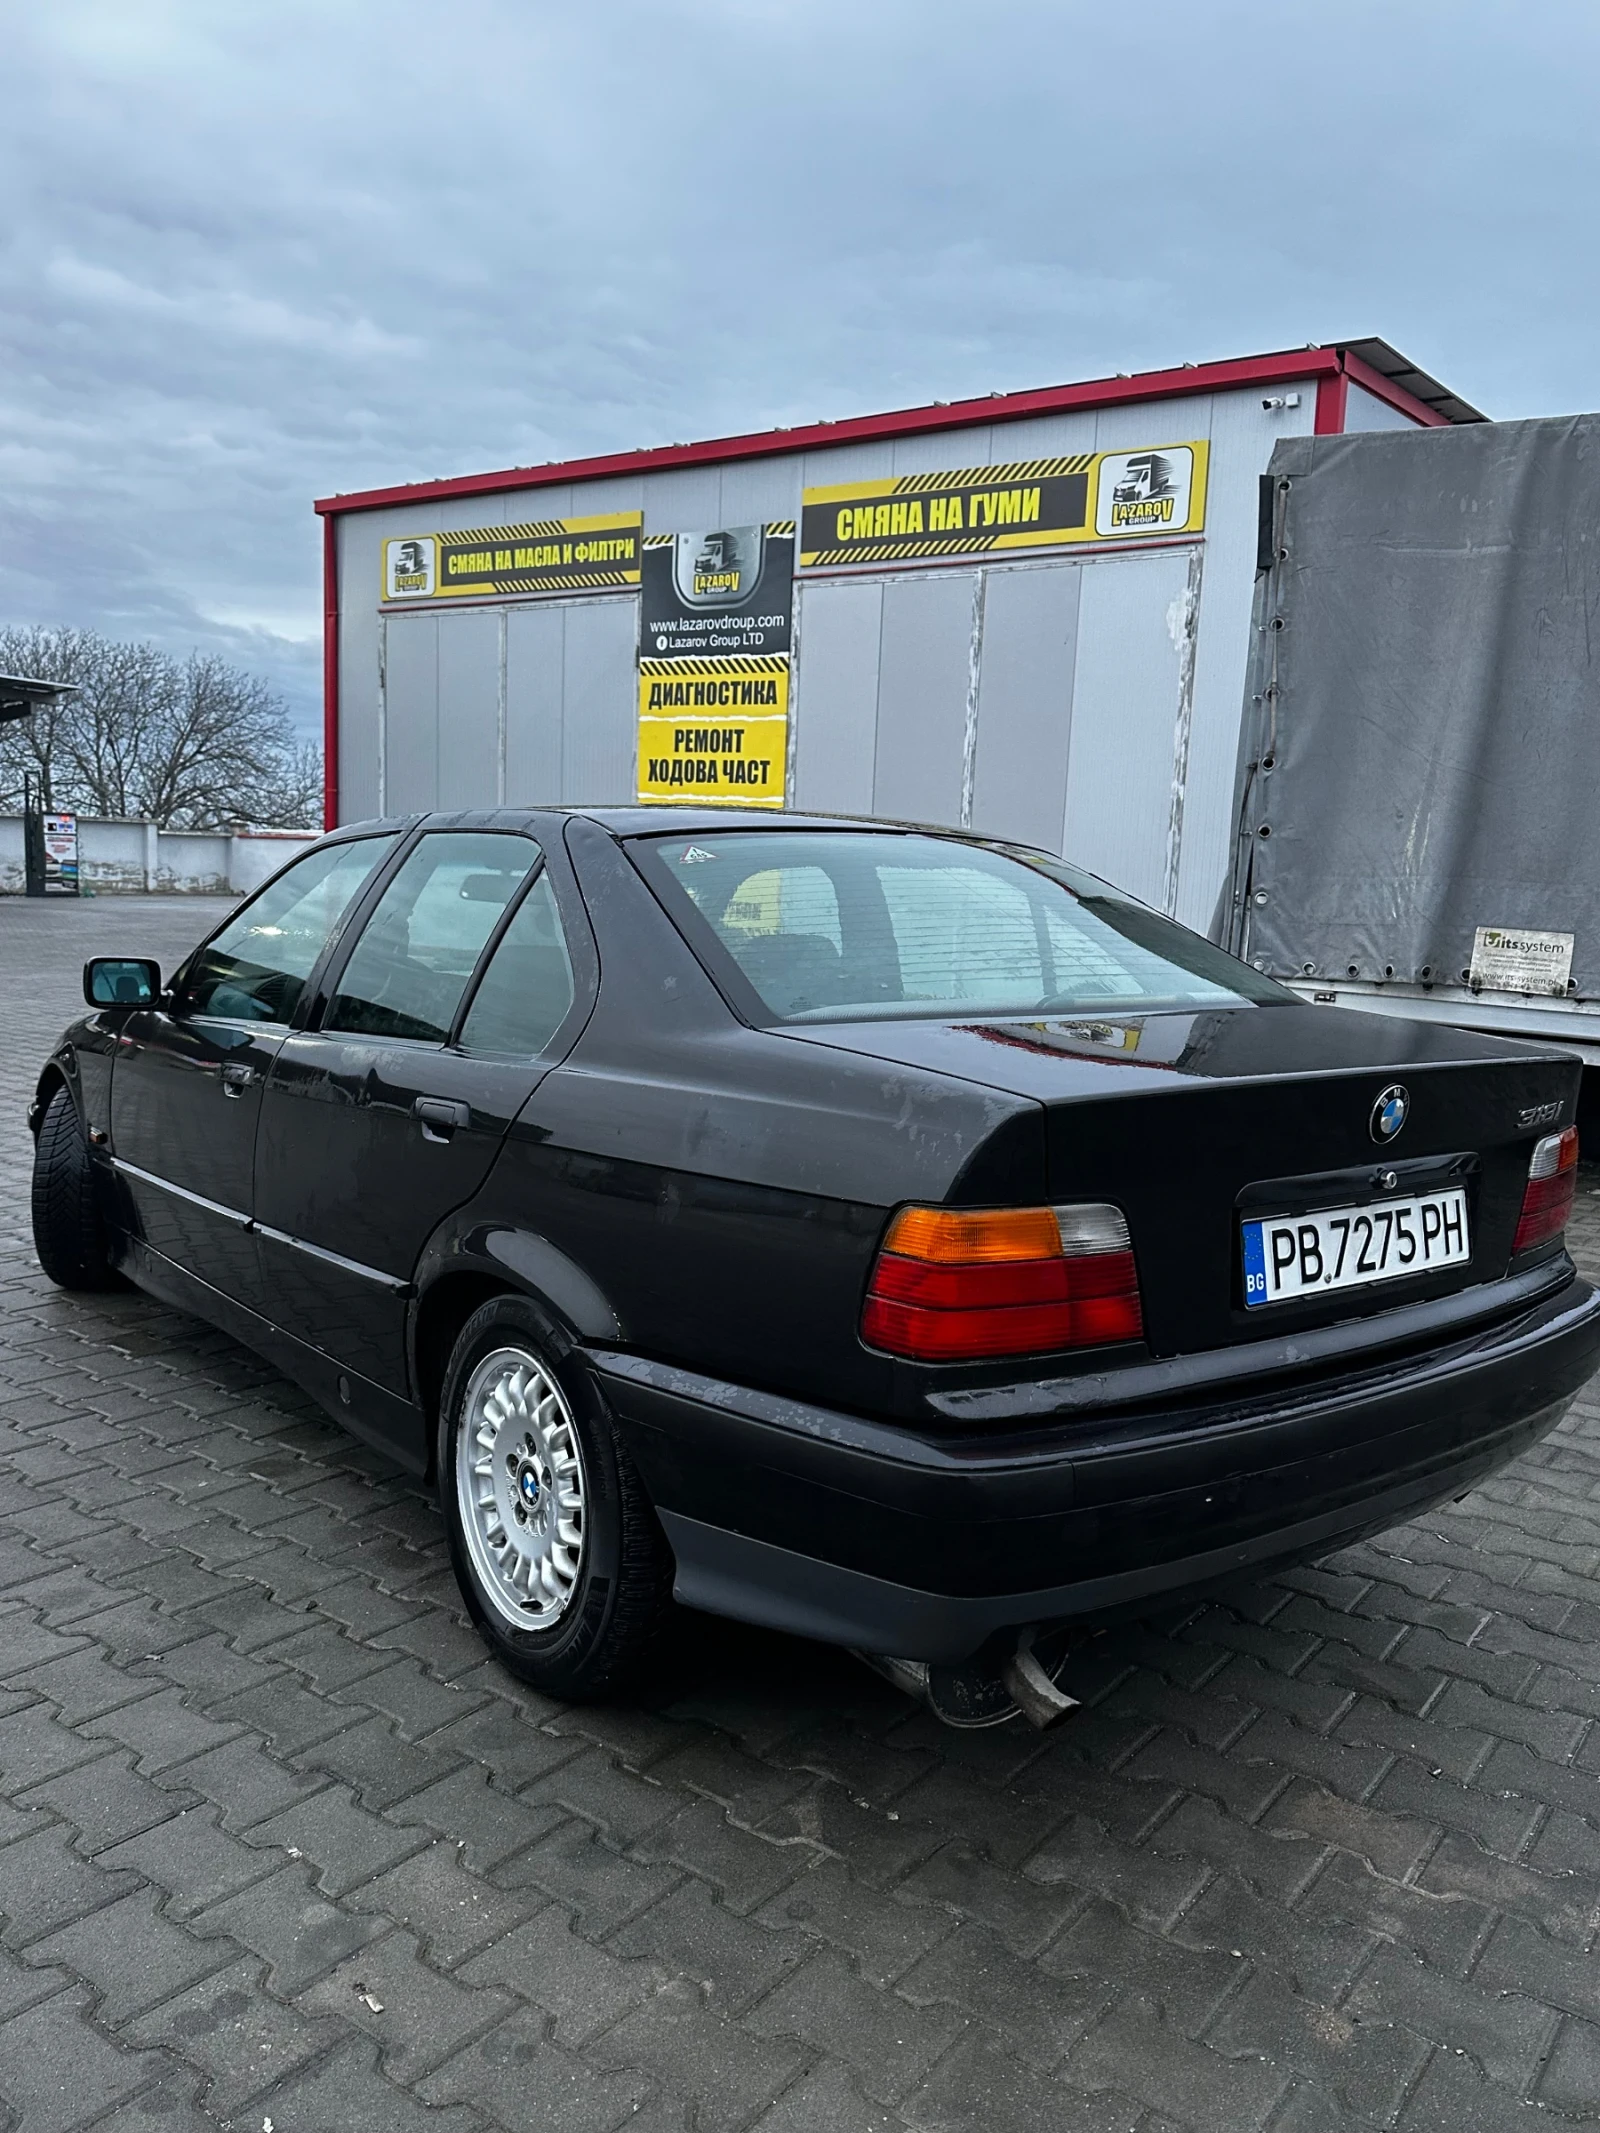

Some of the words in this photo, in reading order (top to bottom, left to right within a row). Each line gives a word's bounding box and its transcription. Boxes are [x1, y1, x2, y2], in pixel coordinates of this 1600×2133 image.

[837, 500, 924, 541] СМЯНА
[929, 496, 963, 532] НА
[969, 487, 1041, 527] ГУМИ
[1112, 499, 1174, 526] LAZAROV
[1128, 515, 1156, 525] GROUP
[448, 552, 493, 575] СМЯНА
[495, 549, 513, 571] НА
[514, 545, 561, 569] МАСЛА
[563, 543, 572, 565] И
[575, 538, 635, 563] ФИЛТРИ
[695, 571, 740, 595] LAZAROV
[650, 615, 785, 633] www.lazarovdroup.com
[668, 636, 708, 648] Lazarov
[709, 634, 741, 648] Group
[743, 632, 764, 645] LTD
[648, 680, 778, 710] ДИАГНОСТИКА
[674, 729, 745, 753] РЕМОНТ
[648, 759, 719, 786] ХОДОВА
[723, 760, 771, 784] ЧАСТ
[1247, 1274, 1265, 1292] BG
